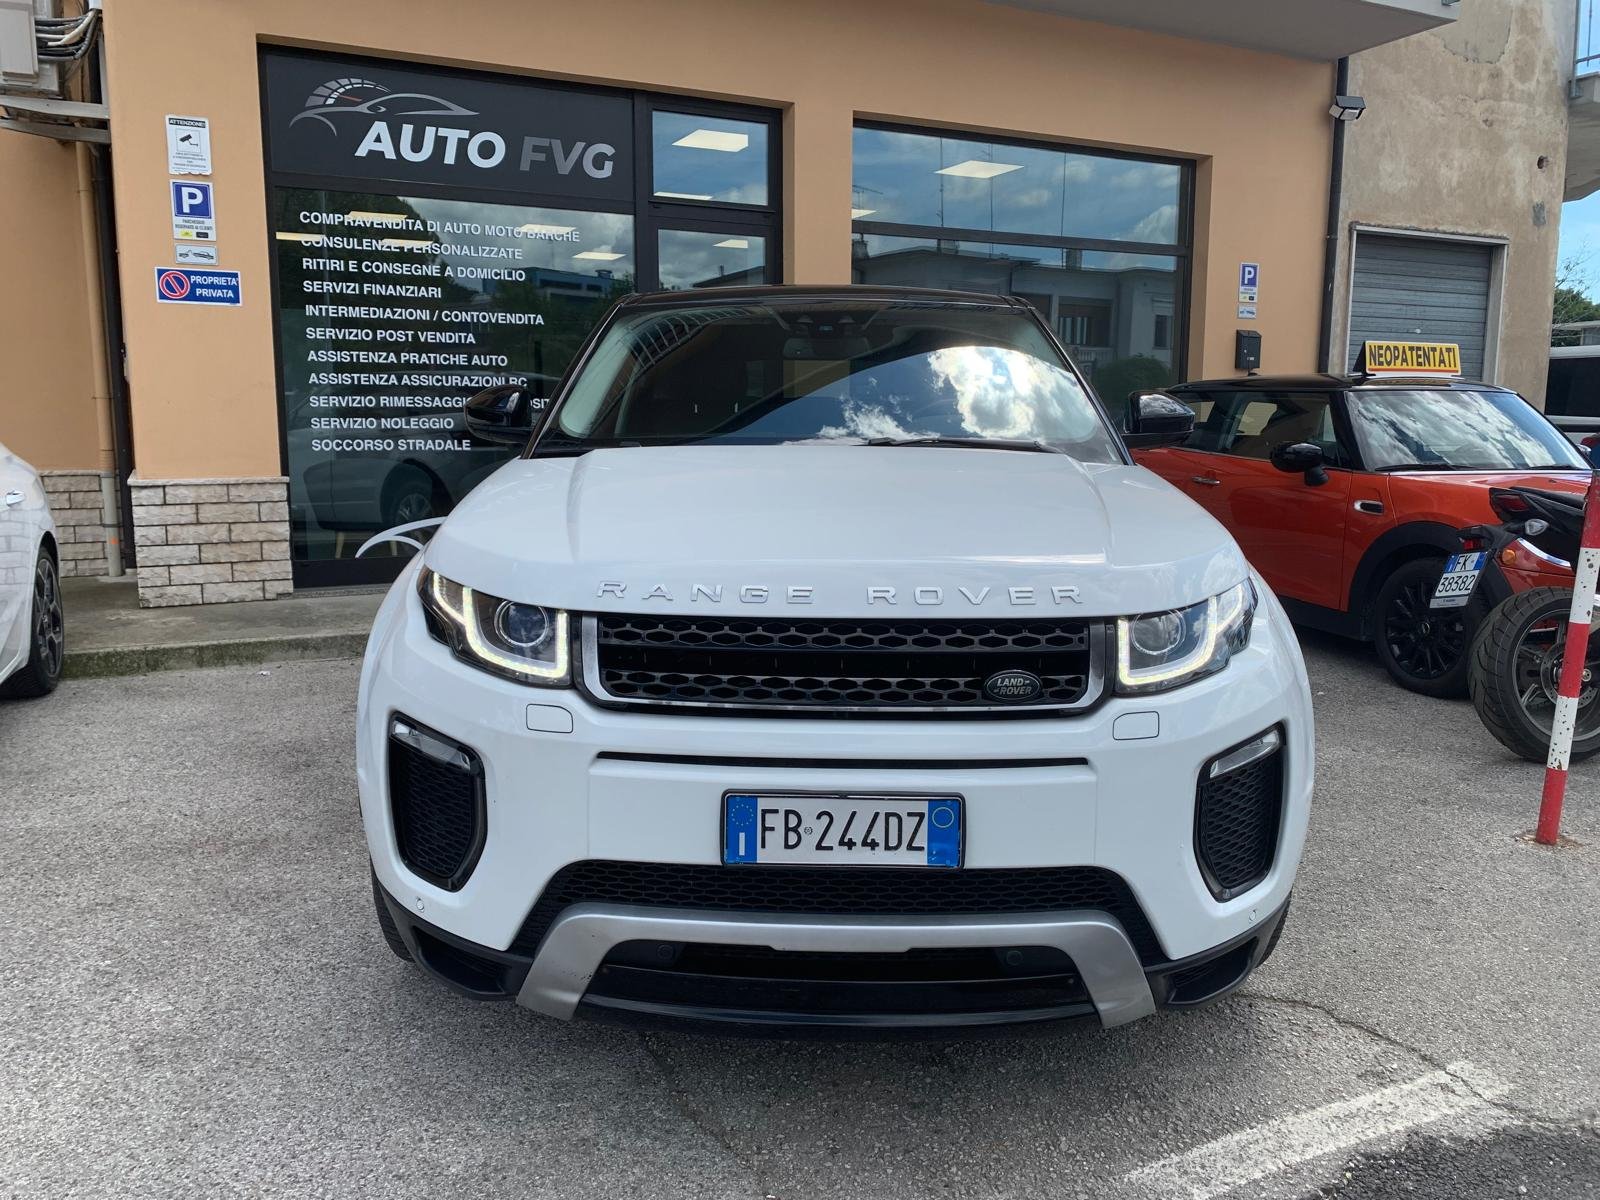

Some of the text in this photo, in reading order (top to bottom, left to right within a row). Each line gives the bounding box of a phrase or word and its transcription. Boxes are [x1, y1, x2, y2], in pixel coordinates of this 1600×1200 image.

[354, 120, 616, 179] AUTO FVG
[181, 187, 203, 214] P
[299, 211, 580, 242] COMPRAVENDITA DI AUTO MOTO BARCHE
[301, 234, 523, 260] CONSULENZE PERSONALIZZATE
[302, 258, 526, 282] RITIRI E CONSEGNE A DOMICILIO
[1244, 266, 1255, 285] P
[195, 288, 234, 298] PRIVATA
[302, 280, 442, 298] SERVIZI FINANZIARI
[305, 304, 430, 321] INTERMEDIAZIONI
[441, 310, 545, 325] CONTOVENDITA
[305, 327, 476, 344] SERVIZIO POST VENDITA
[307, 350, 508, 367] ASSISTENZA PRATICHE AUTO
[1368, 345, 1457, 368] NEOPATENTATI
[308, 373, 528, 388] ASSISTENZA ASSICURAZIONI RC
[309, 395, 376, 408] SERVIZIO
[310, 417, 454, 430] SERVIZIO NOLEGGIO
[311, 439, 471, 452] SOCCORSO STRADALE
[1454, 554, 1472, 571] FK
[597, 580, 1084, 606] RANGE ROVER
[1437, 574, 1476, 593] 38382
[760, 808, 803, 850] FB
[815, 810, 926, 851] 244DZ
